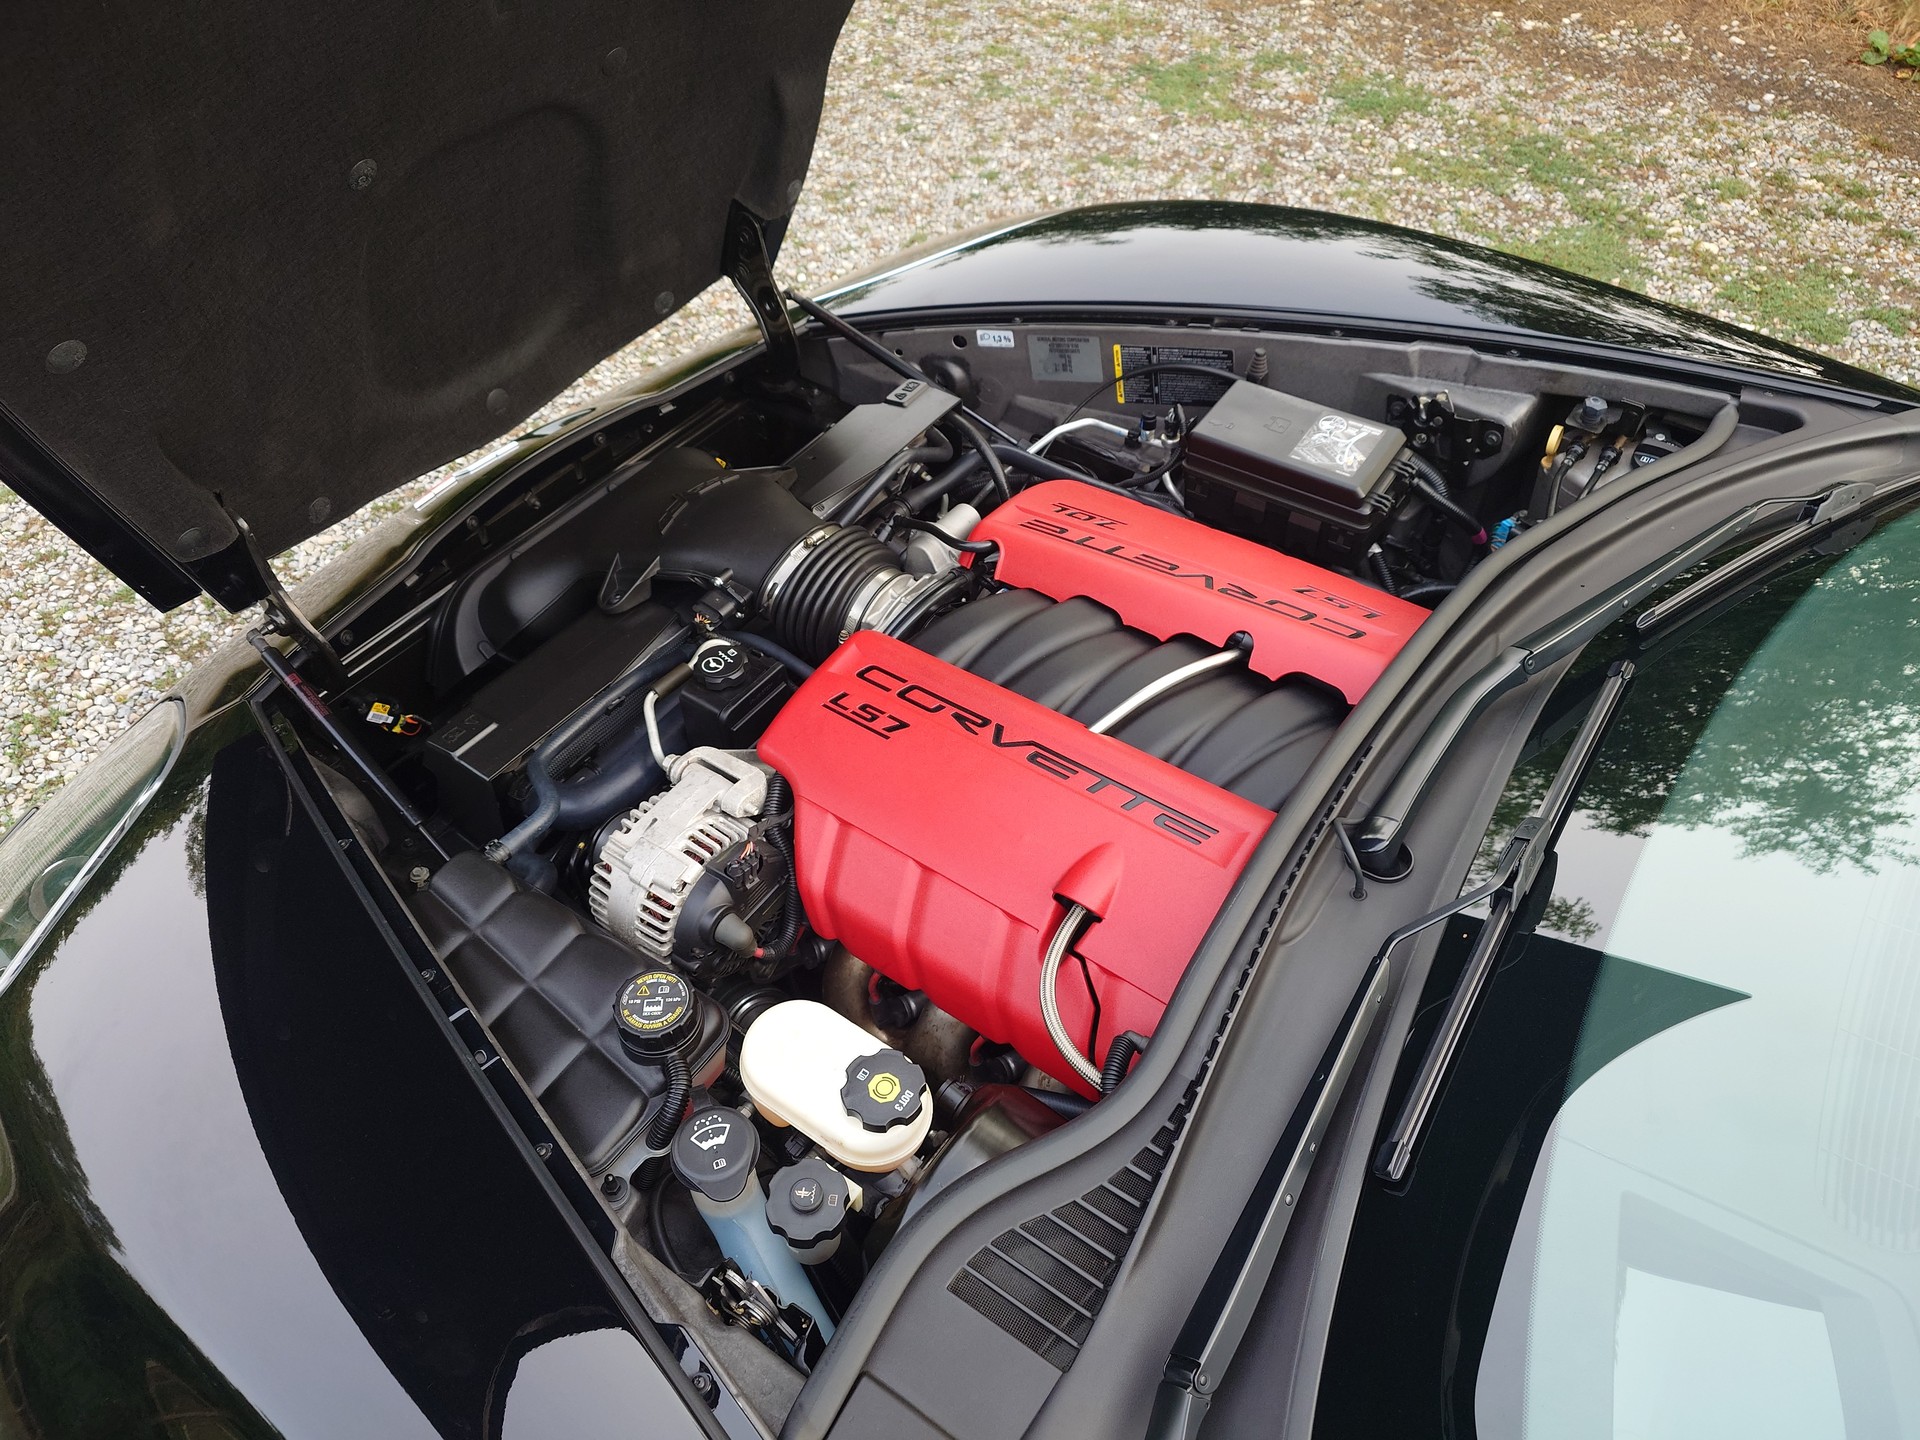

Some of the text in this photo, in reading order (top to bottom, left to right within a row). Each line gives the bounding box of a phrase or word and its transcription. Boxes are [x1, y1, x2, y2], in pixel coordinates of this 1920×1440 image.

[1050, 501, 1127, 531] 7.0L
[1019, 518, 1367, 640] CORVETTE
[1293, 584, 1386, 620] LS7
[822, 691, 911, 740] LS7
[855, 663, 1220, 846] CORVETTE
[636, 973, 677, 985] NEVER OPEN HOT!
[626, 1016, 643, 1029] JAMAIS
[894, 1089, 914, 1112] DOT 3
